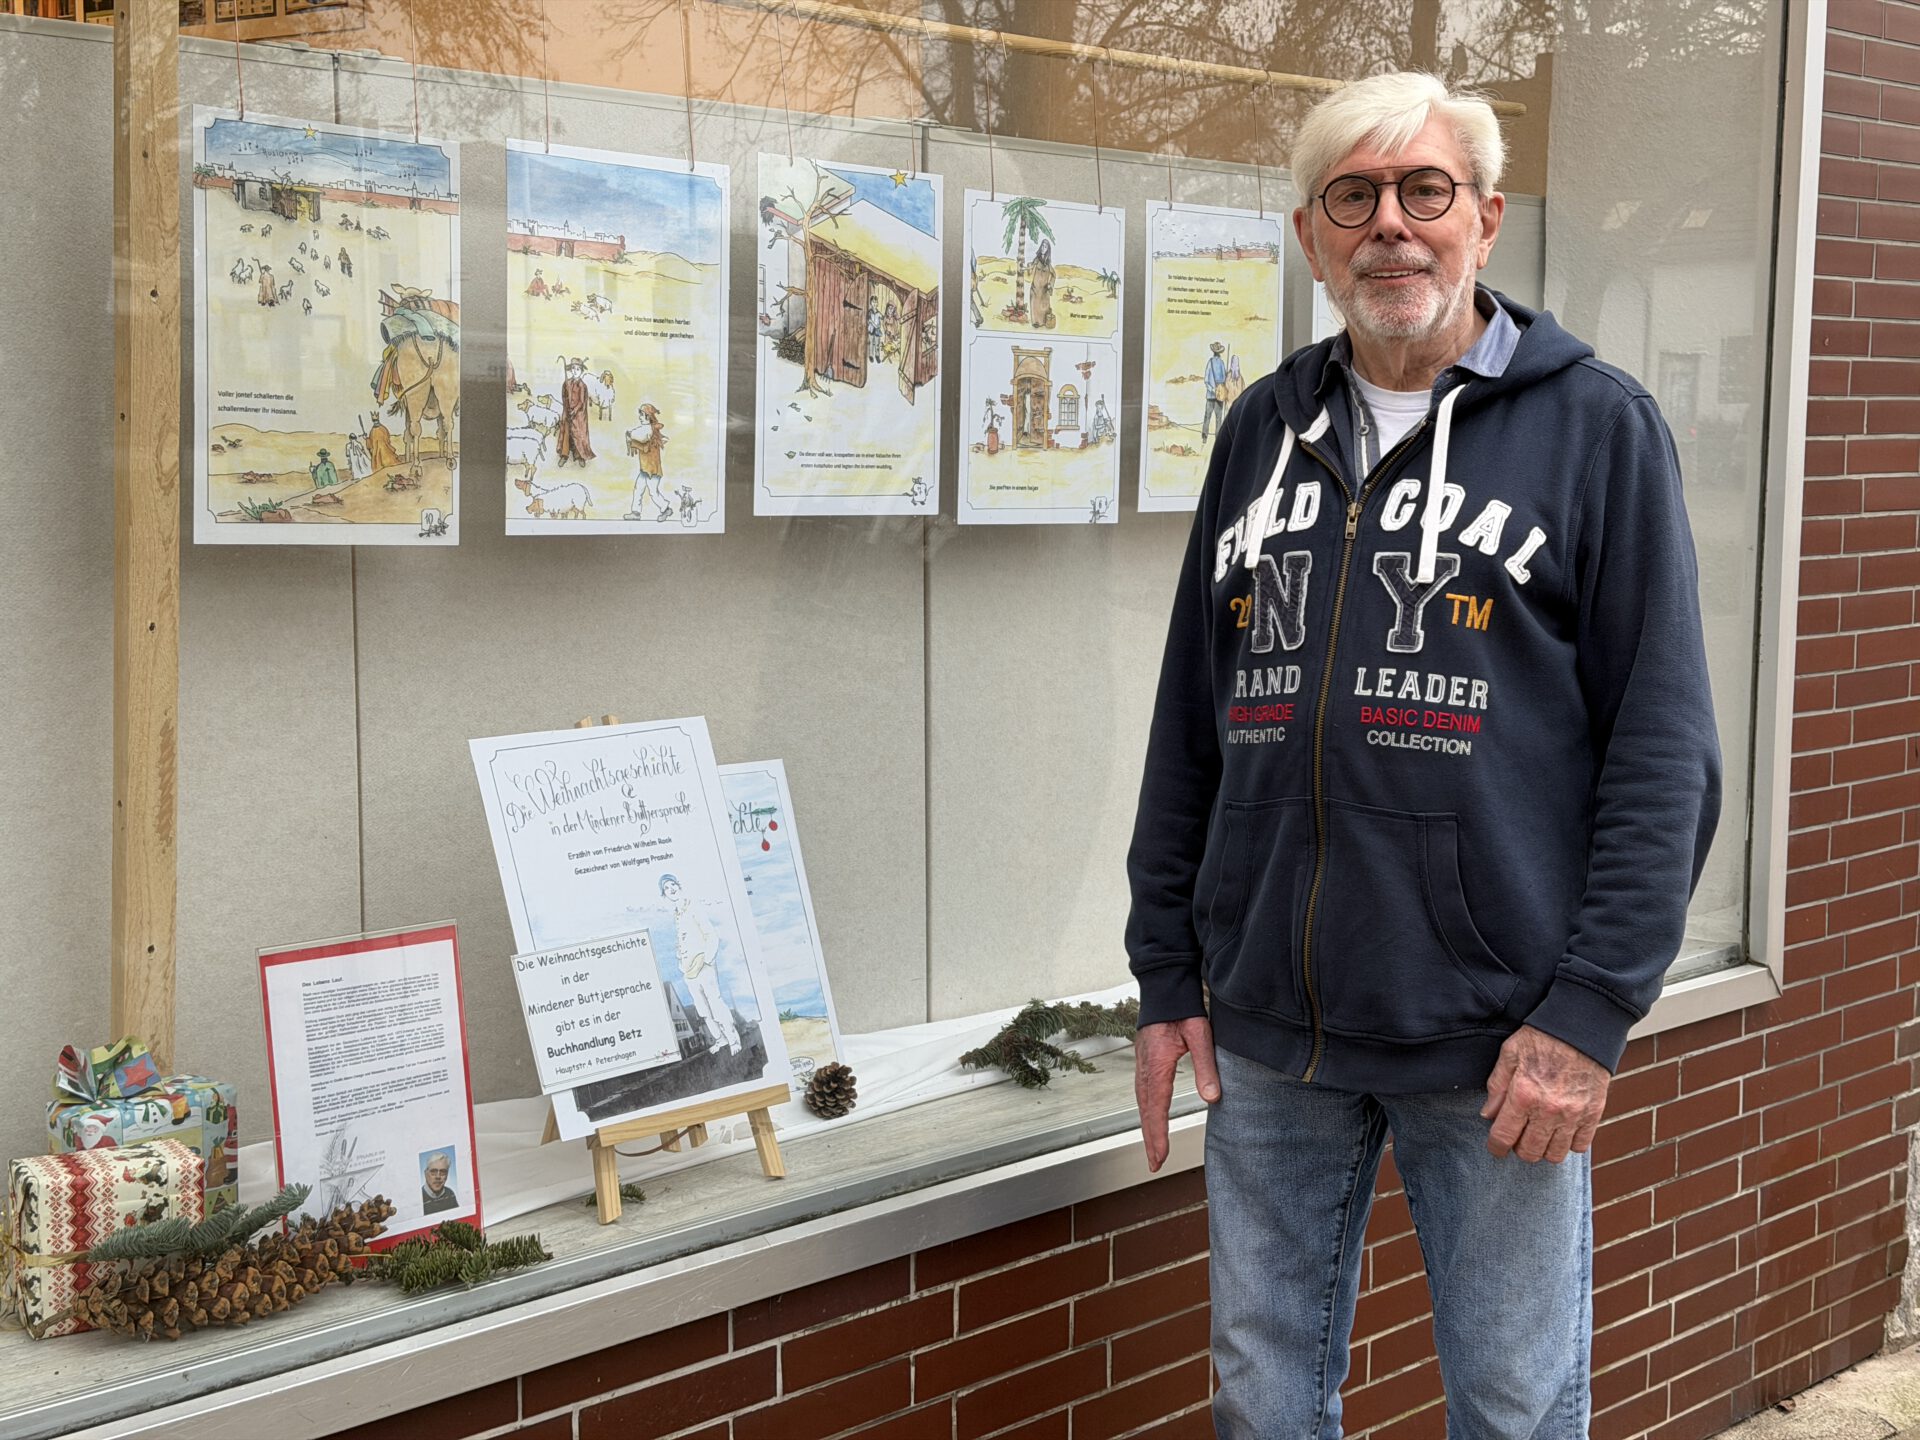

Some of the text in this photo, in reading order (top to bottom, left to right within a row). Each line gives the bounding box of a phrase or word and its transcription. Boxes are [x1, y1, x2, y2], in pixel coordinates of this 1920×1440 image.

[1446, 593, 1494, 631] TM
[1234, 665, 1489, 710] RAND LEADER
[1255, 703, 1296, 722] GRADE
[1360, 706, 1481, 733] BASIC DENIM
[1227, 726, 1472, 755] AUTHENTIC COLLECTION
[505, 744, 686, 833] Die Weihnachtsgeschichte
[549, 791, 693, 837] in der Mindener Buttjersprache
[567, 850, 591, 860] Erzählt
[604, 844, 632, 854] Friedrich
[633, 840, 657, 849] Wilhelm
[574, 864, 608, 875] Gezeichnet
[621, 857, 650, 868] Wolfgang
[516, 937, 648, 972] Die Weihnachtsgeschichte
[561, 971, 590, 986] in der
[528, 980, 652, 1017] Mindener Buttjersprache
[555, 1010, 622, 1037] gibt es in der
[546, 1028, 643, 1058] Buchhandlung Betz
[595, 1050, 637, 1066] Petershagen
